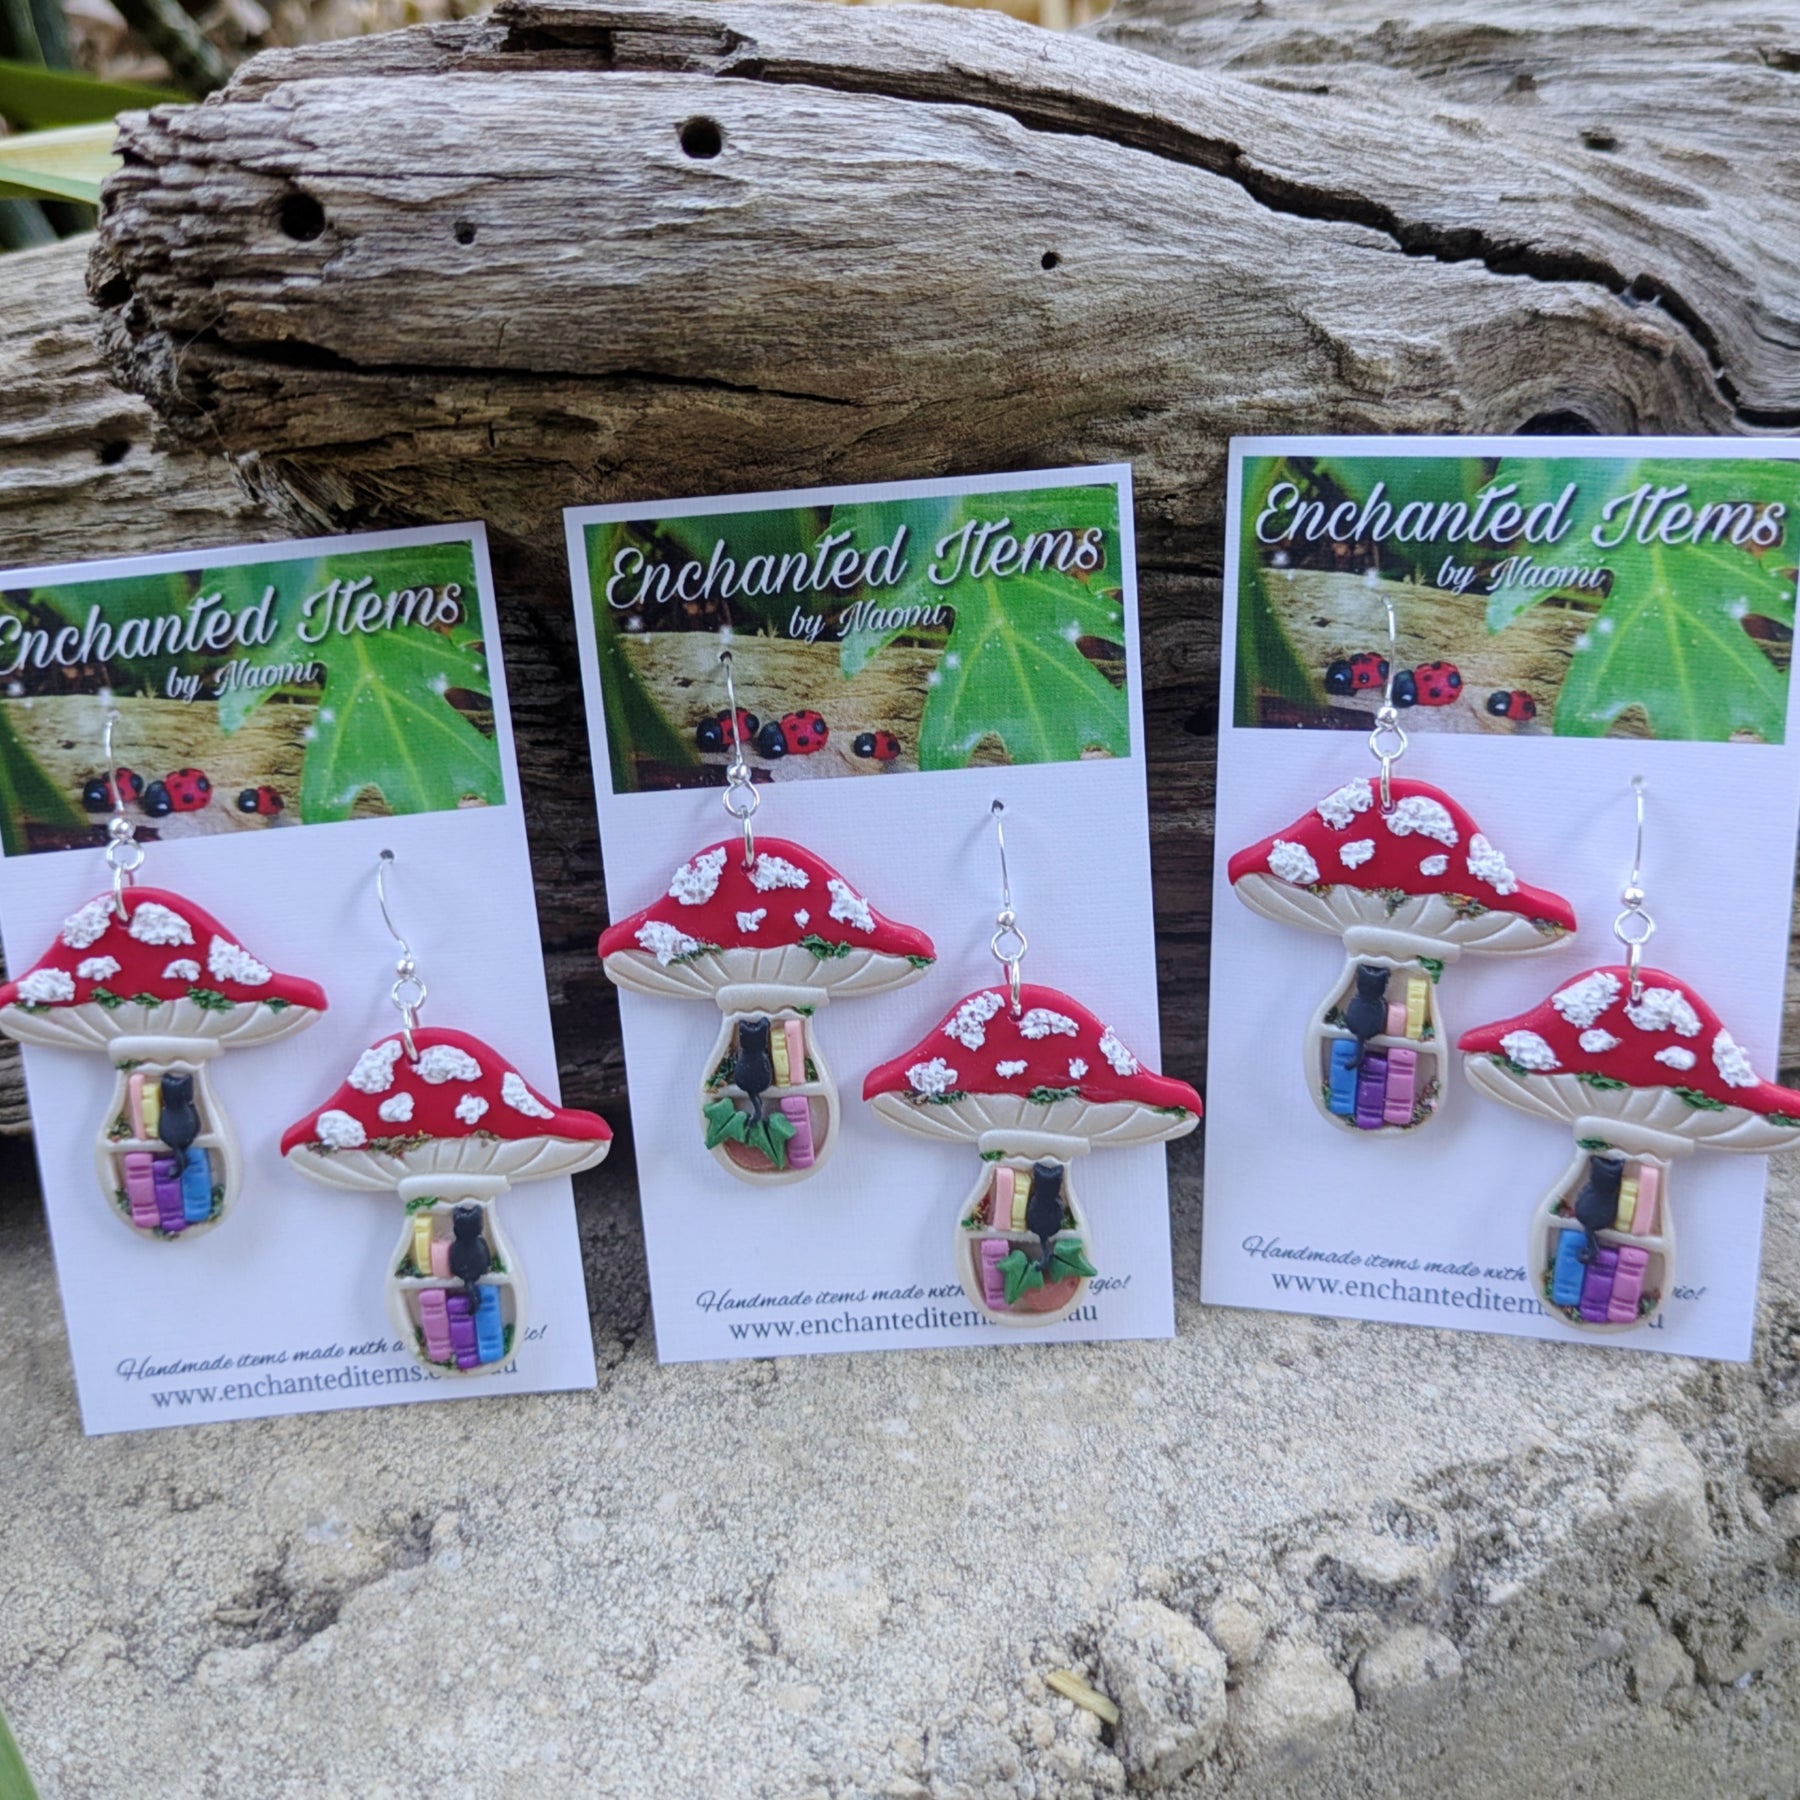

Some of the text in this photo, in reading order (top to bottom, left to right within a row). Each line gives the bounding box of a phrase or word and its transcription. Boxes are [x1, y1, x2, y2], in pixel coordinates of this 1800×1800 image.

[1255, 480, 1787, 550] Enchanted Items
[606, 517, 1103, 610] Enchanted Items
[1436, 555, 1608, 594] by Naomi
[0, 575, 462, 676] Enchanted Items
[788, 596, 948, 643] by Naomi
[166, 652, 319, 704] by Naomi
[1241, 1235, 1528, 1282] Handmade items made with
[696, 1288, 813, 1313] Handmade
[815, 1288, 868, 1305] items
[872, 1284, 925, 1302] made
[116, 1337, 405, 1382] Handmade items made with a
